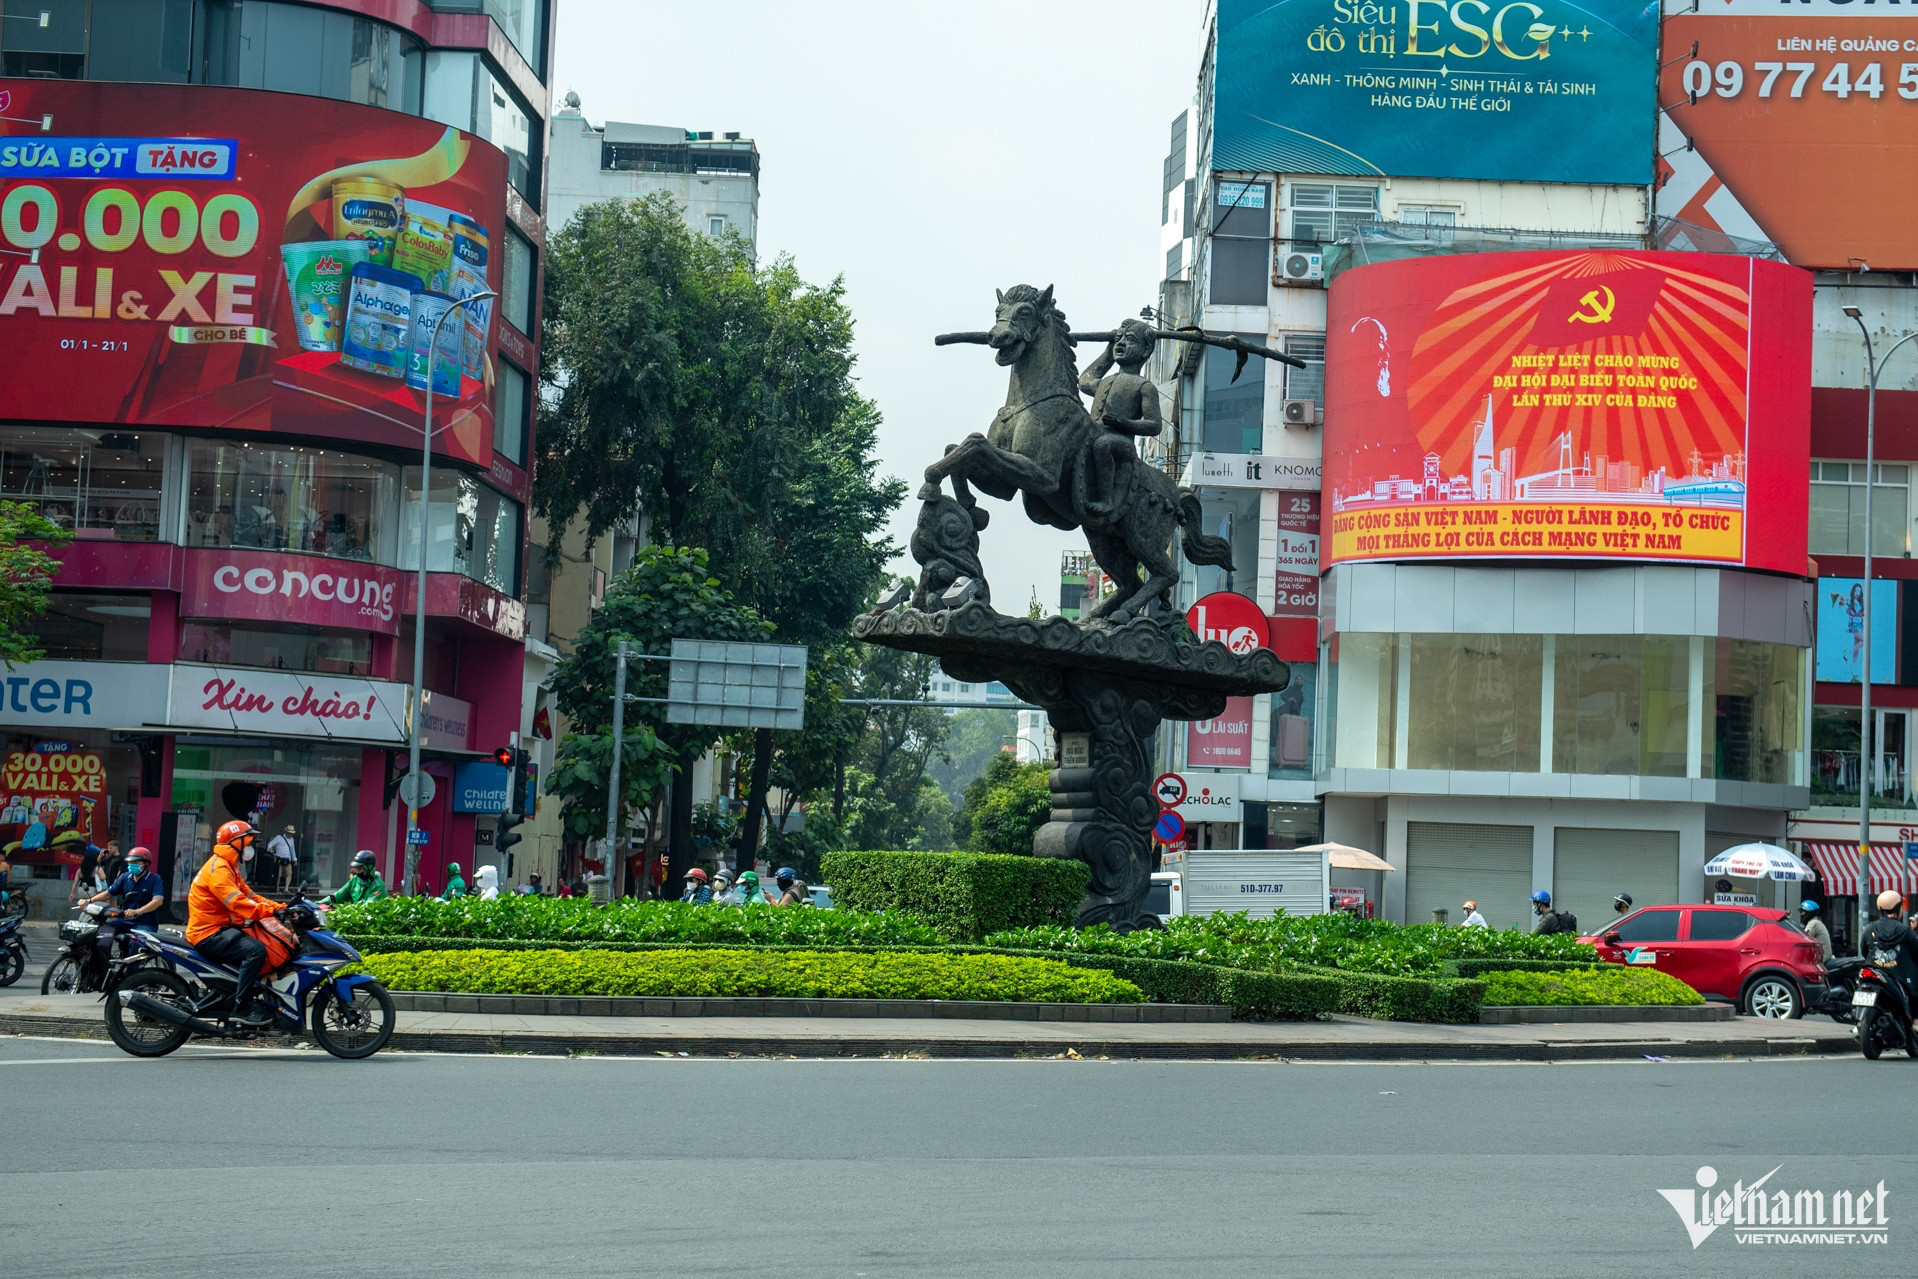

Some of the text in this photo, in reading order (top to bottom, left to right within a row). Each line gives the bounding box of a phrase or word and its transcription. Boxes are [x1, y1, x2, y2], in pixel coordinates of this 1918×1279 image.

[1333, 0, 1396, 25] Siêu
[1306, 24, 1396, 58] đô thị
[1777, 36, 1812, 51] LIÊN
[1816, 36, 1837, 53] HỆ
[1840, 36, 1900, 52] QUẢNG
[1291, 72, 1331, 86] XANH
[1344, 72, 1396, 88] THÔNG
[1399, 76, 1437, 90] MINH
[1450, 79, 1485, 92] SINH
[1488, 78, 1521, 93] THÁI
[1524, 82, 1534, 94] &
[1537, 79, 1558, 94] TÁI
[1561, 82, 1596, 96] SINH
[1682, 60, 1744, 98] 09
[1754, 62, 1815, 98] 77
[1822, 62, 1884, 98] 44
[1371, 91, 1511, 112] HÀNG ĐẦU THẾ GIỚI
[1, 142, 218, 174] SỮA BỘT TẶNG
[402, 231, 449, 260] ColosBaby
[459, 243, 480, 261] Friso
[354, 291, 411, 316] Alphage
[193, 327, 247, 341] CHO BÉ
[417, 314, 456, 335] Aptmil
[60, 338, 88, 350] 01/1
[101, 339, 129, 352] 21/1
[1511, 352, 1680, 370] NHIỆT LIỆT CHÀO MỪNG
[1493, 370, 1698, 391] ĐẠI HỘI ĐẠI BIỂU TOÀN QUỐC
[1512, 390, 1677, 409] LẦN THỨ XIV CỦA ĐẢNG
[1246, 461, 1262, 480] it
[1291, 497, 1311, 513] 25
[1280, 519, 1299, 527] QUỐC
[1334, 513, 1355, 534] ĐẢNG
[1357, 511, 1391, 532] CỘNG
[1394, 508, 1421, 528] SẢN
[1424, 507, 1459, 529] VIỆT
[1462, 510, 1499, 526] NAM
[1511, 506, 1563, 525] NGƯỜI
[1568, 507, 1613, 526] LÃNH
[1616, 511, 1657, 530] ĐẠO,
[1662, 507, 1684, 528] TỔ
[1688, 511, 1730, 531] CHỨC
[1281, 538, 1289, 553] 1
[1309, 539, 1316, 554] 1
[1357, 527, 1682, 554] MỌI THẮNG LỢI CỦA CÁCH MẠNG VIỆT NAM
[1278, 555, 1318, 565] 365 NGÀY
[1278, 575, 1312, 583] GIAO HÀNG
[1277, 590, 1317, 606] 2 GIỜ
[203, 677, 377, 721] Xin chào!
[1212, 720, 1226, 734] LÃI
[1227, 719, 1249, 735] SUẤT
[8, 752, 100, 774] 30.000
[464, 789, 508, 799] Childre
[1240, 884, 1284, 893] 51D-377.97
[1716, 894, 1732, 902] SỬA
